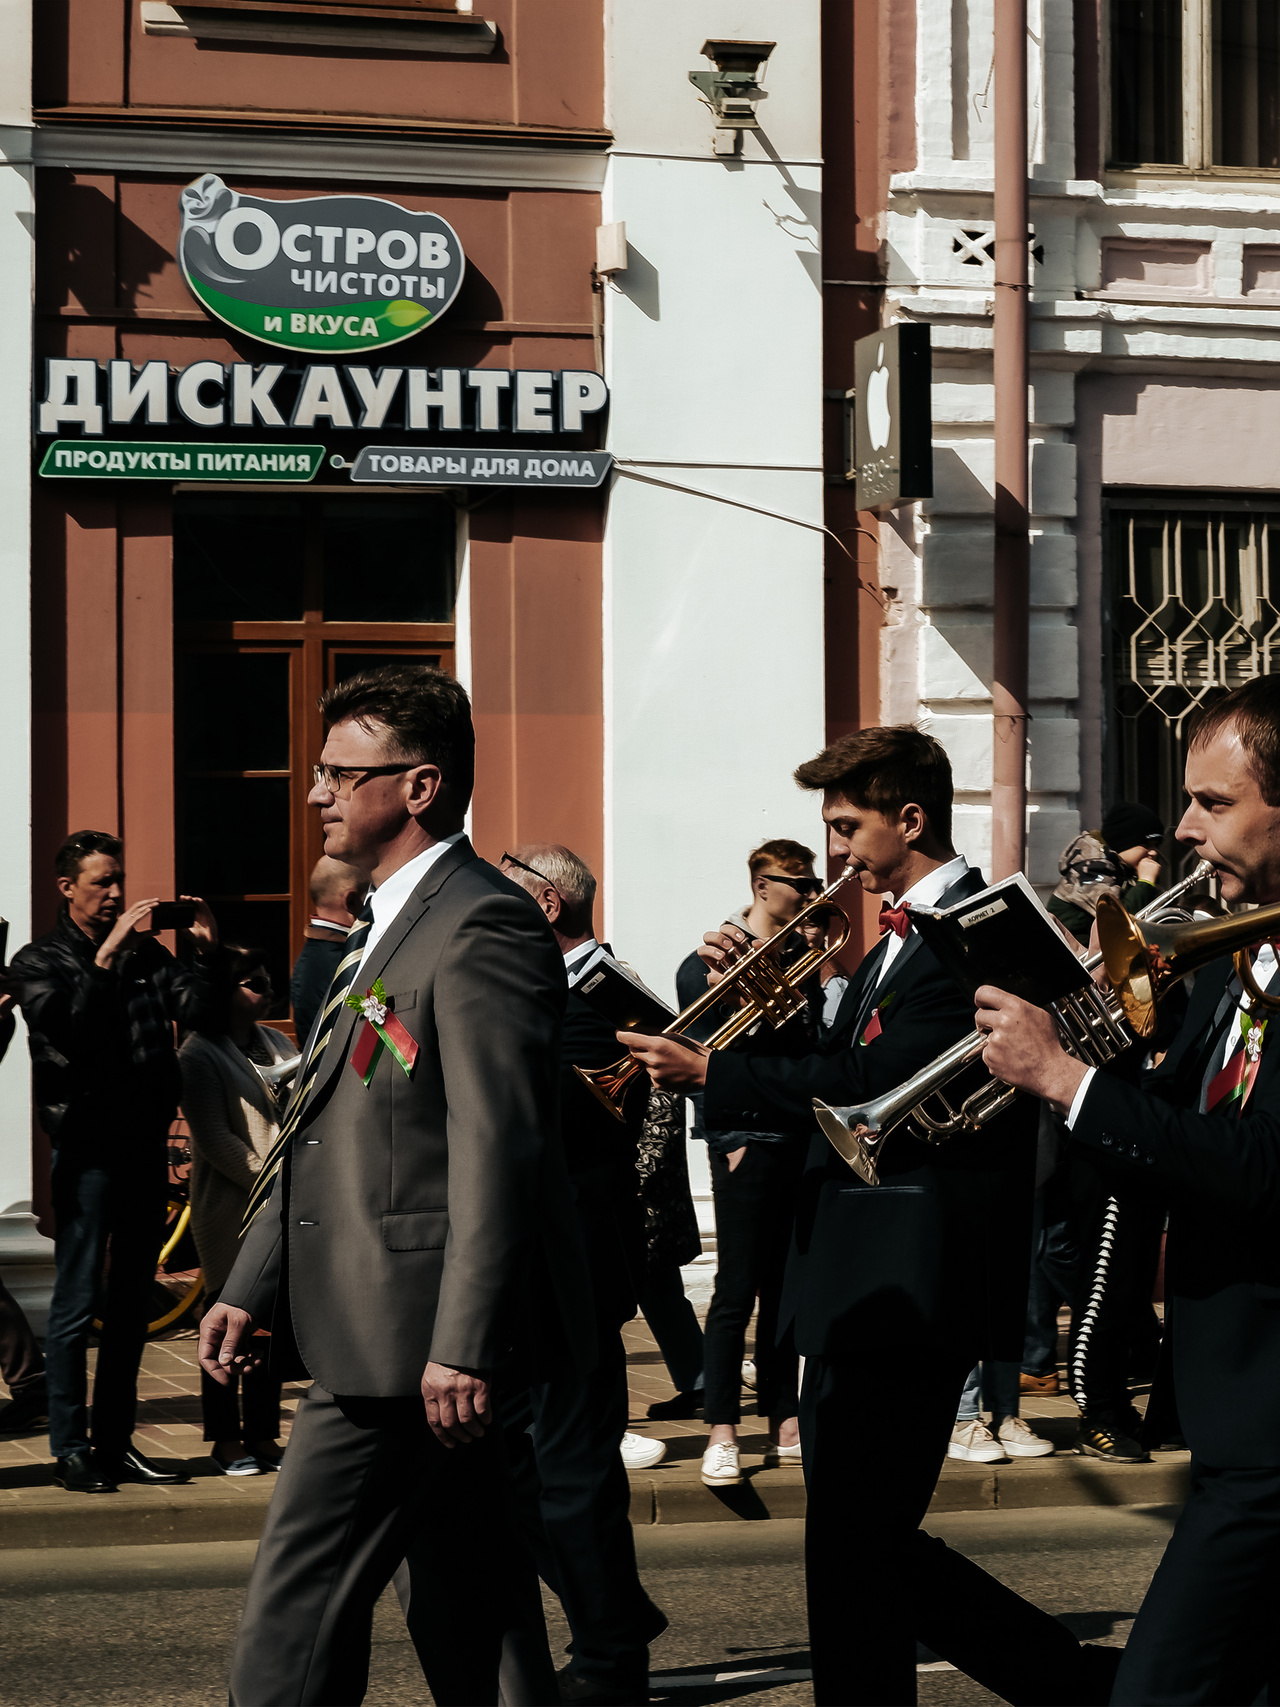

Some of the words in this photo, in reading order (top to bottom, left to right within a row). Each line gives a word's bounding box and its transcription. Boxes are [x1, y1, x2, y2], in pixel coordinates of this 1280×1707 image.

[290, 268, 446, 300] ЧИСТОТЫ
[290, 312, 380, 338] ВКУСА
[37, 357, 608, 436] ДИСКАУНТЕР
[54, 449, 191, 473] ПРОДУКТЫ
[197, 452, 312, 473] ПИТАНИЯ
[367, 454, 468, 475] ТОВАРЫ
[470, 457, 522, 479] ДЛЯ
[523, 459, 597, 480] ДОМА
[967, 910, 989, 923] КОРНЕТ
